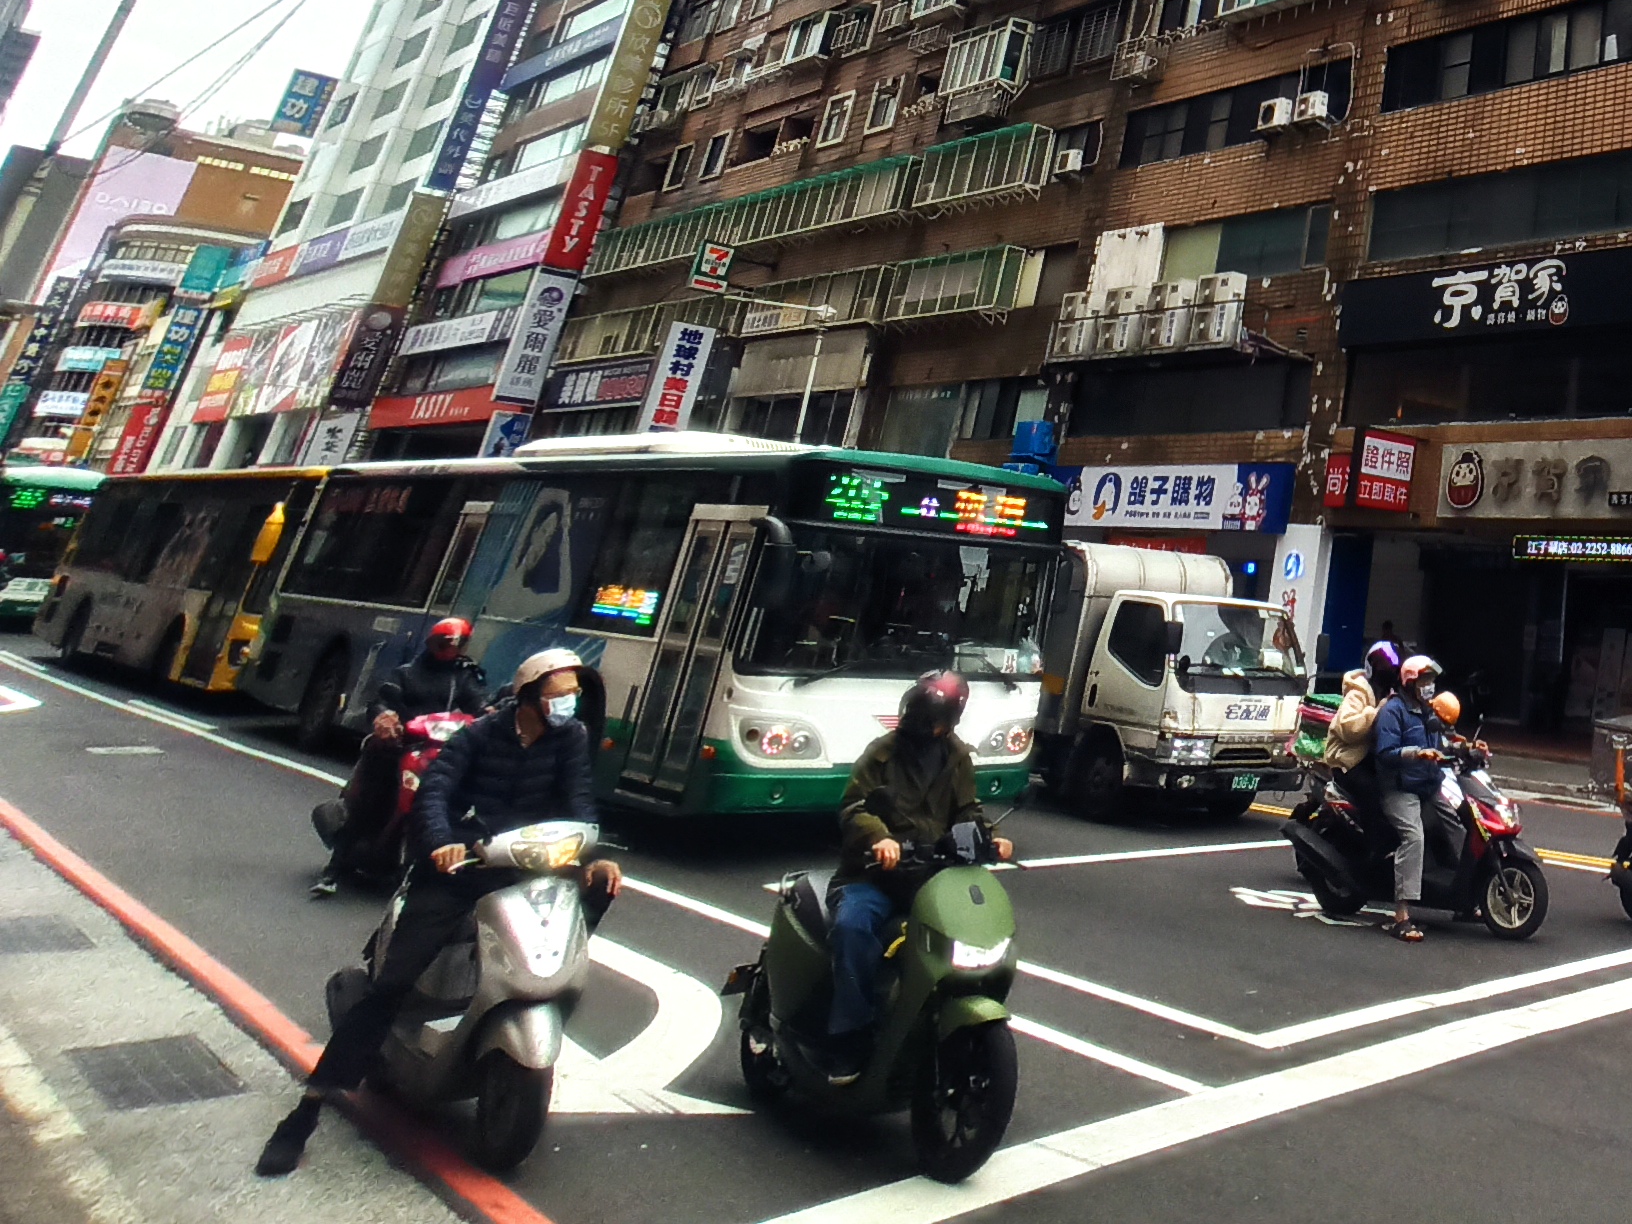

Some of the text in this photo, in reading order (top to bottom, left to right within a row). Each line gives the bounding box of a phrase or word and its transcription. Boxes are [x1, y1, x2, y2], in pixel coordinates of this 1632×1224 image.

[562, 165, 603, 253] TASTY
[1431, 258, 1566, 328] 京賀家
[410, 393, 454, 419] TASTY
[1363, 443, 1412, 476] 證件照
[1127, 475, 1216, 507] 鴿子購物
[1358, 479, 1408, 505] 立即取件
[1224, 703, 1271, 721] 宅配通
